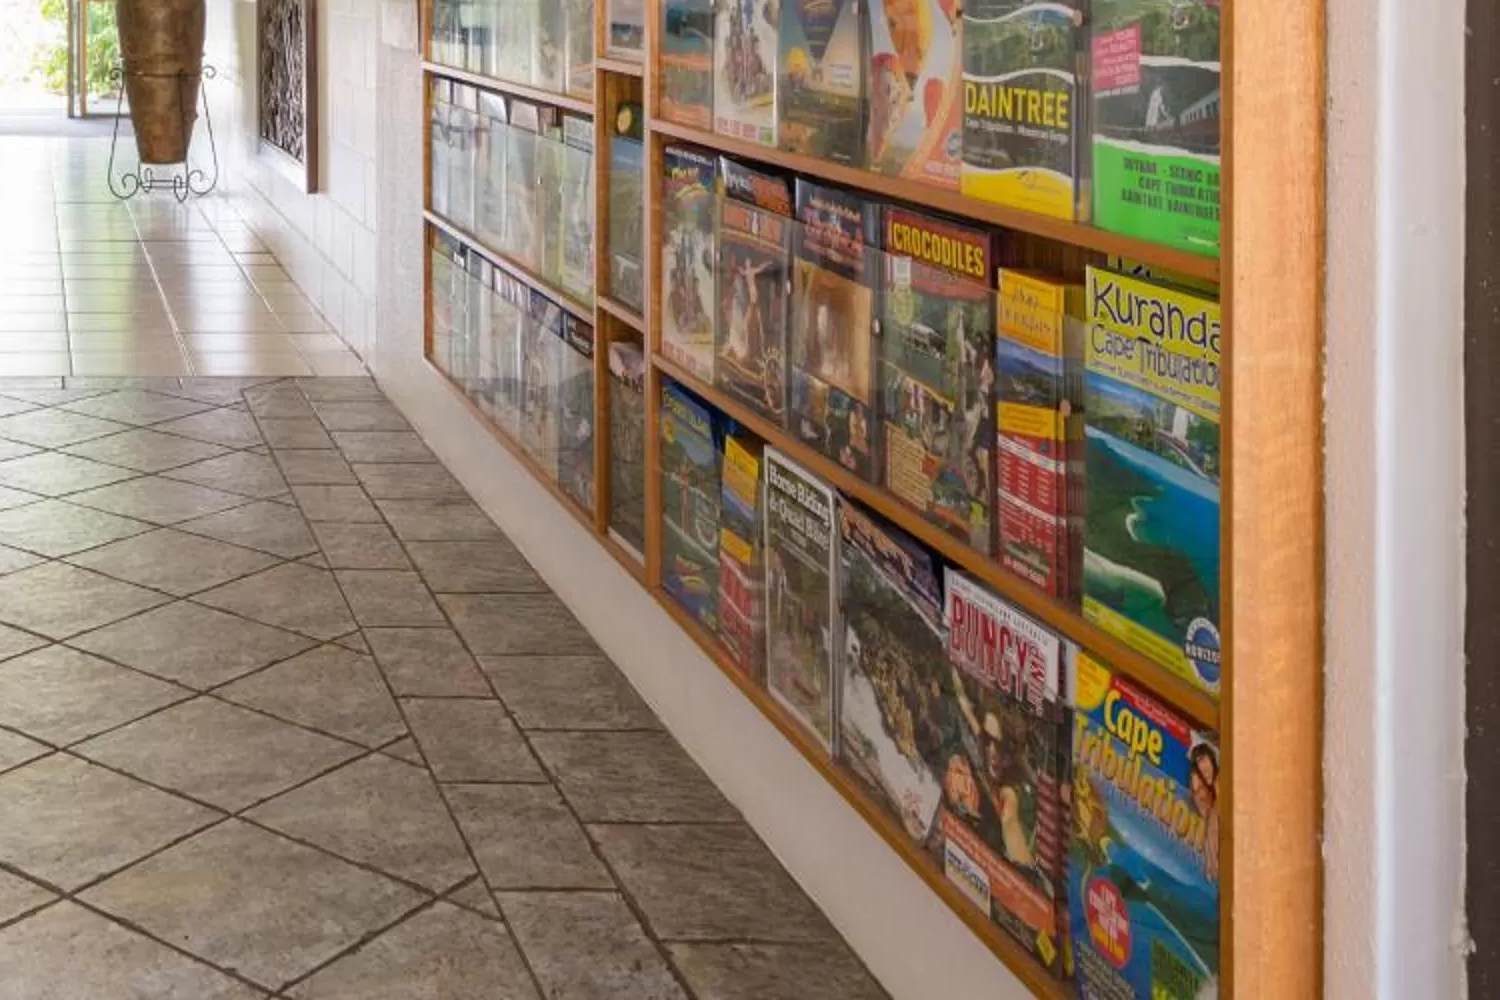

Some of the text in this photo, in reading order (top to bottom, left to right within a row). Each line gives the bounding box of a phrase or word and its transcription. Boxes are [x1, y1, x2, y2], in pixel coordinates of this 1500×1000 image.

[964, 82, 1069, 129] DAINTREE
[1165, 180, 1220, 202] TRIBULATIO
[891, 220, 985, 278] CROCODILES
[1092, 276, 1220, 354] Kuranda
[1092, 323, 1134, 361] Cape
[1137, 335, 1220, 394] Tribulatio
[951, 592, 1029, 703] BUNGY
[1103, 688, 1164, 765] Cape
[1074, 713, 1205, 854] Tribulation
